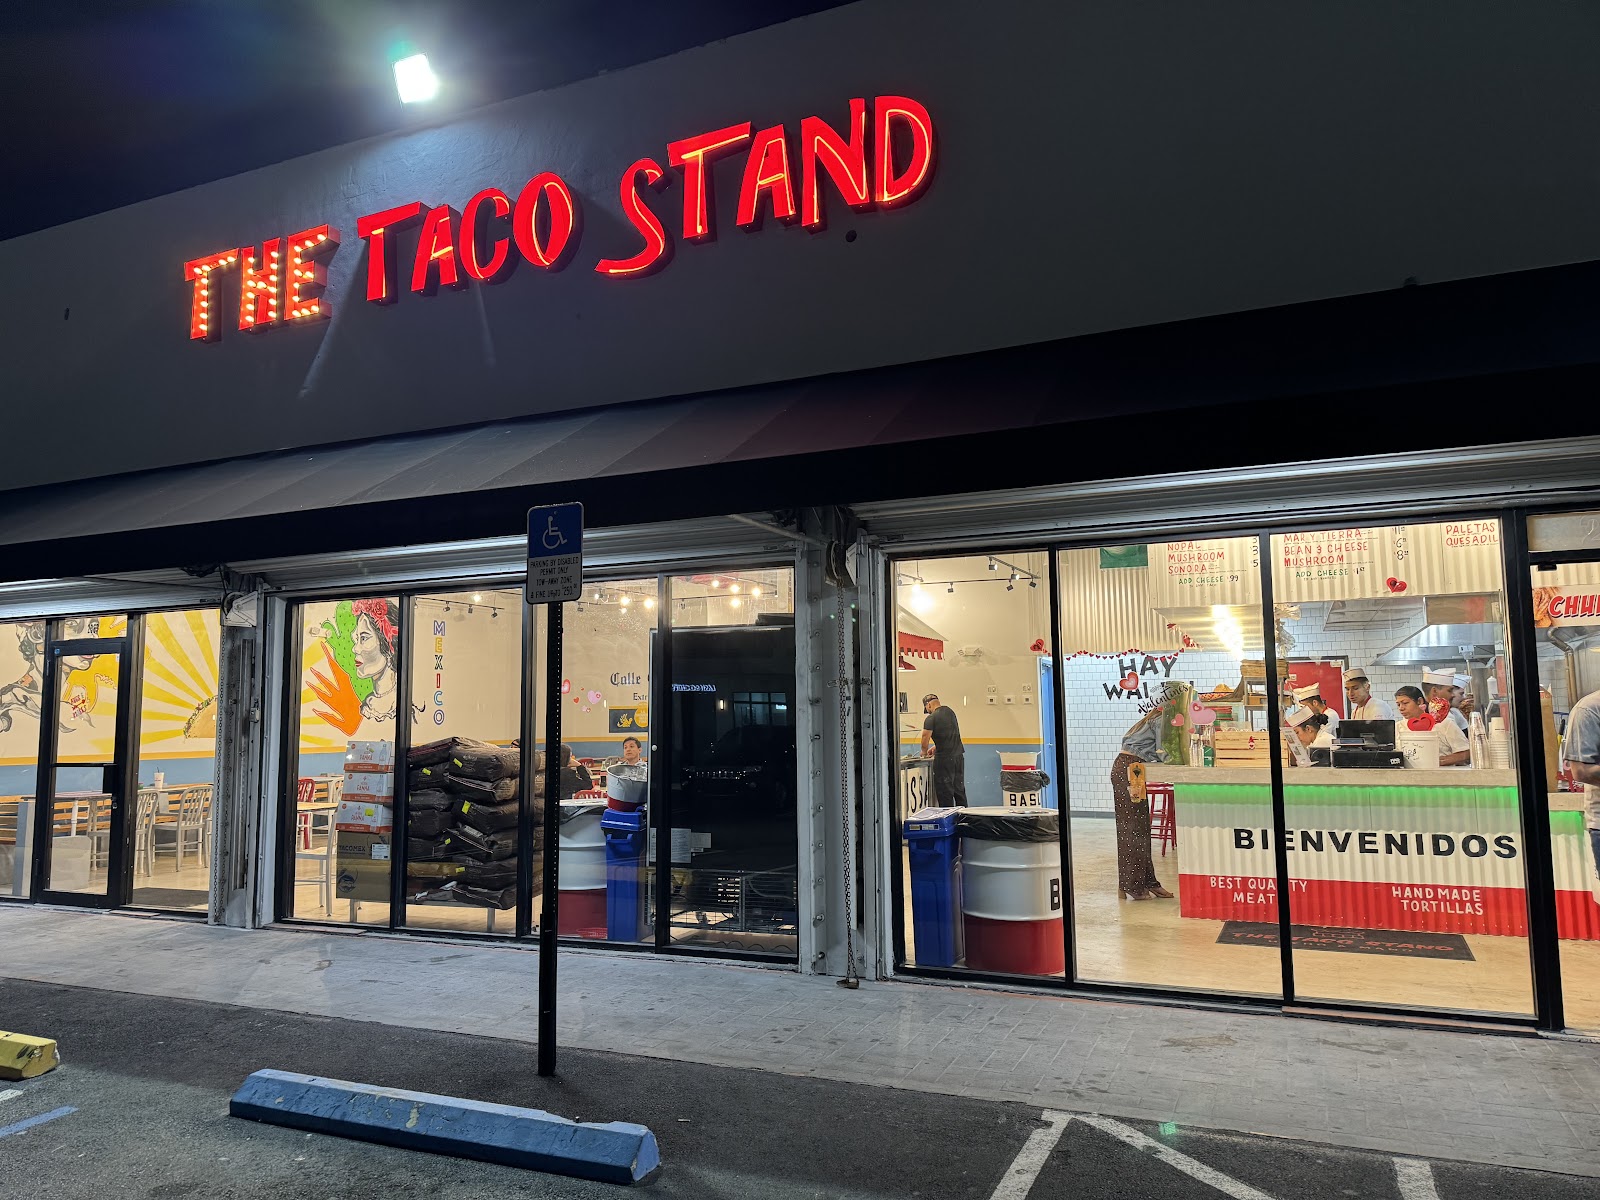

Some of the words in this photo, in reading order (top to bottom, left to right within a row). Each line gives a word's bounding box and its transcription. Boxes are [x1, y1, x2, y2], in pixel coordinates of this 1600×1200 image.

[184, 224, 334, 340] THE
[357, 171, 573, 302] TACO
[594, 96, 933, 274] STAND
[1446, 522, 1496, 535] PALETAS
[1283, 533, 1305, 543] MAR
[1309, 533, 1316, 541] Y
[1321, 528, 1362, 540] TIERRA
[1167, 541, 1202, 551] NOPAL
[1284, 545, 1312, 556] BEAN
[1327, 541, 1368, 554] CHEESE
[530, 559, 549, 568] PARKING
[550, 559, 557, 567] BY
[557, 557, 579, 566] DISABLED
[1168, 551, 1225, 562] MUSHROOM
[1284, 555, 1344, 567] MUSHROOM
[540, 567, 556, 576] PERMIT
[557, 566, 568, 574] ONLY
[1168, 564, 1207, 574] SONORA
[1317, 568, 1349, 576] CHEESE
[536, 578, 559, 586] TOW-AWAY
[560, 575, 573, 584] ZONE
[1178, 577, 1193, 585] ADD
[1195, 575, 1224, 583] CHEESE
[535, 590, 546, 598] FINE
[1549, 594, 1600, 618] CHU
[433, 619, 446, 726] MEXICO
[1118, 655, 1178, 679] HAY
[610, 671, 642, 687] Calle
[1233, 828, 1518, 860] BIENVENIDOS
[1209, 876, 1243, 889] BEST
[1248, 878, 1309, 893] QUATY
[1232, 891, 1275, 905] MEAT
[1400, 899, 1484, 916] TORTILLAS
